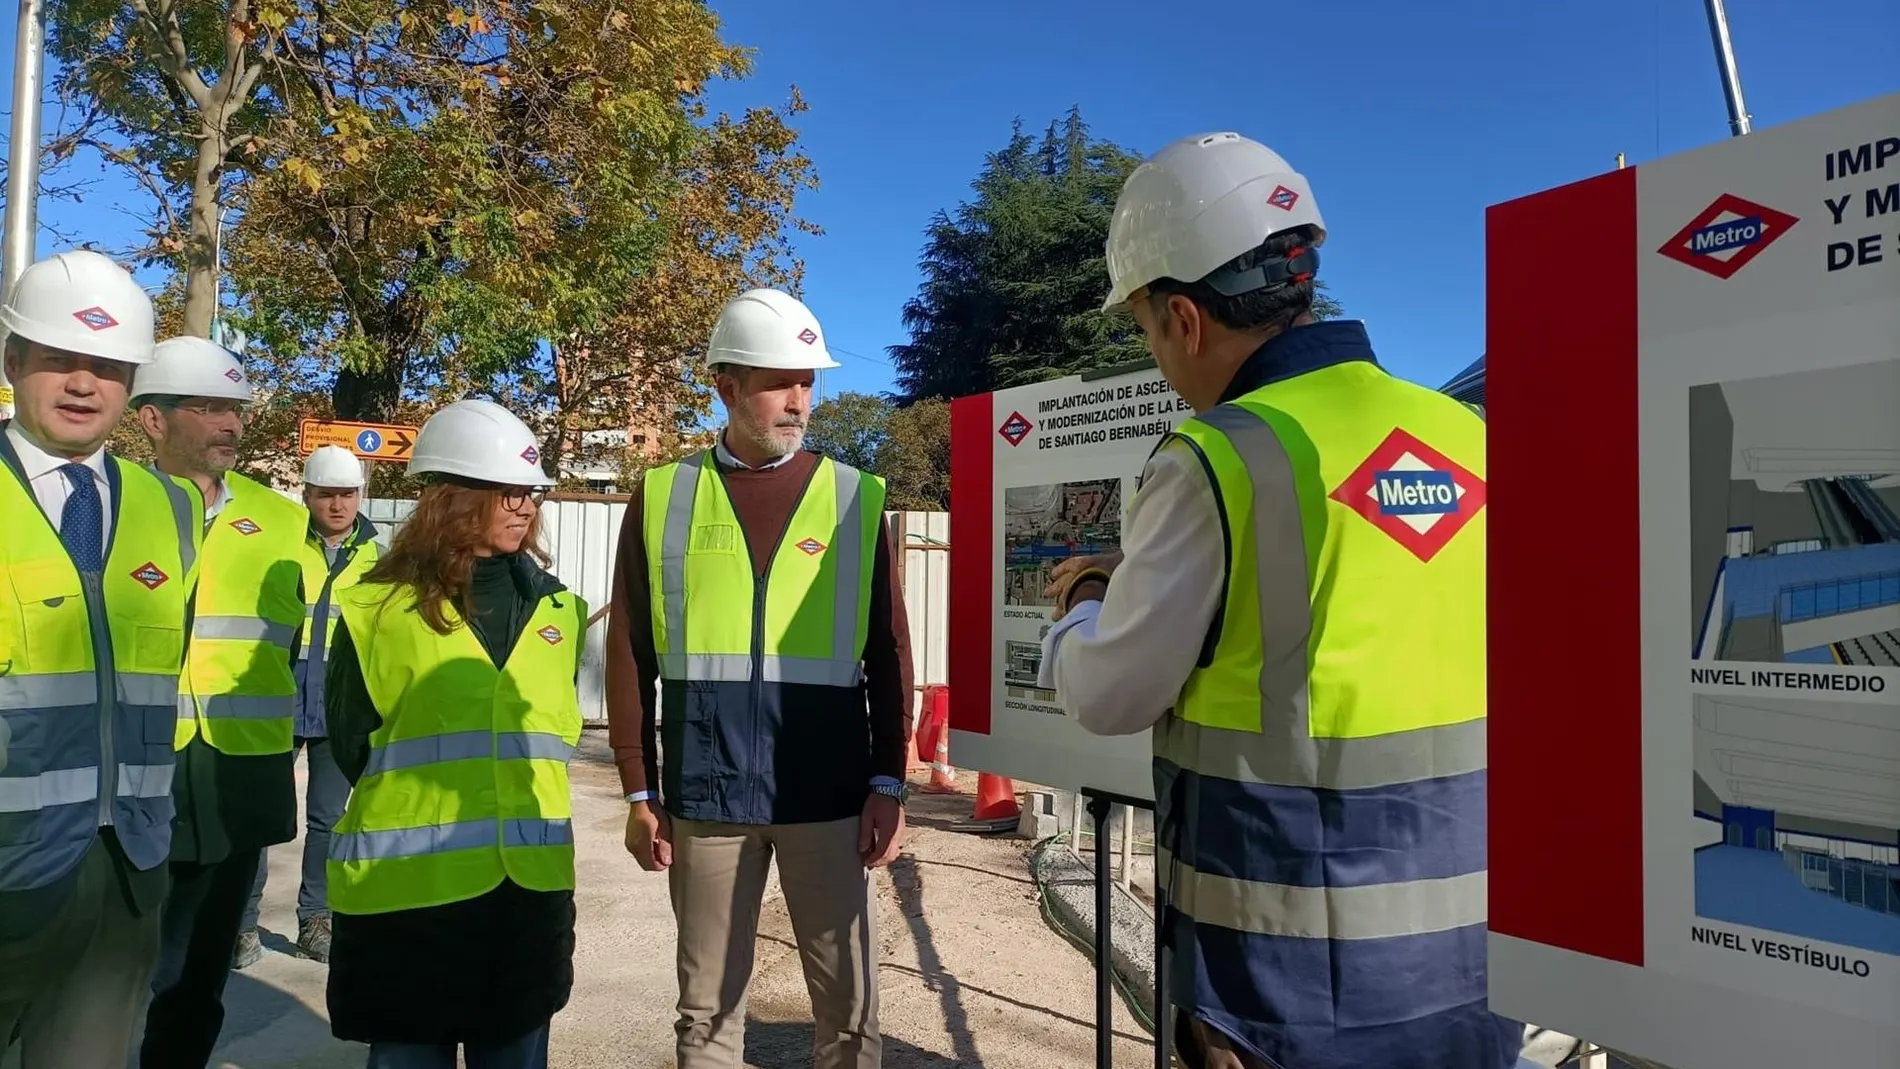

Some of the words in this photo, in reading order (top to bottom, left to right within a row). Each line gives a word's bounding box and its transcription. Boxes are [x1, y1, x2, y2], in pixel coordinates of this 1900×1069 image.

[1826, 137, 1900, 181] IMP
[1824, 194, 1851, 225] Y
[1696, 225, 1756, 250] Metro
[1827, 234, 1882, 272] DE
[1039, 388, 1114, 413] IMPLANTACIÓN
[1117, 386, 1132, 400] DE
[1039, 419, 1045, 431] Y
[1048, 404, 1135, 430] MODERNIZACIÓN
[1139, 402, 1154, 417] DE
[1158, 400, 1173, 414] LA
[305, 434, 352, 443] PROVISIONAL
[1039, 437, 1052, 450] DE
[1054, 429, 1106, 448] SANTIAGO
[1109, 418, 1171, 441] BERNABÉU
[1380, 478, 1451, 506] Metro
[1003, 610, 1023, 619] ESTADO
[1024, 611, 1045, 620] ACTUAL
[1691, 668, 1746, 687] NIVEL
[1751, 670, 1885, 693] INTERMEDIO
[1004, 700, 1028, 710] SECCIÓN
[1028, 704, 1067, 716] LONGITUDINAL
[1691, 926, 1747, 953] NIVEL
[1751, 937, 1870, 977] VESTÍBULO
